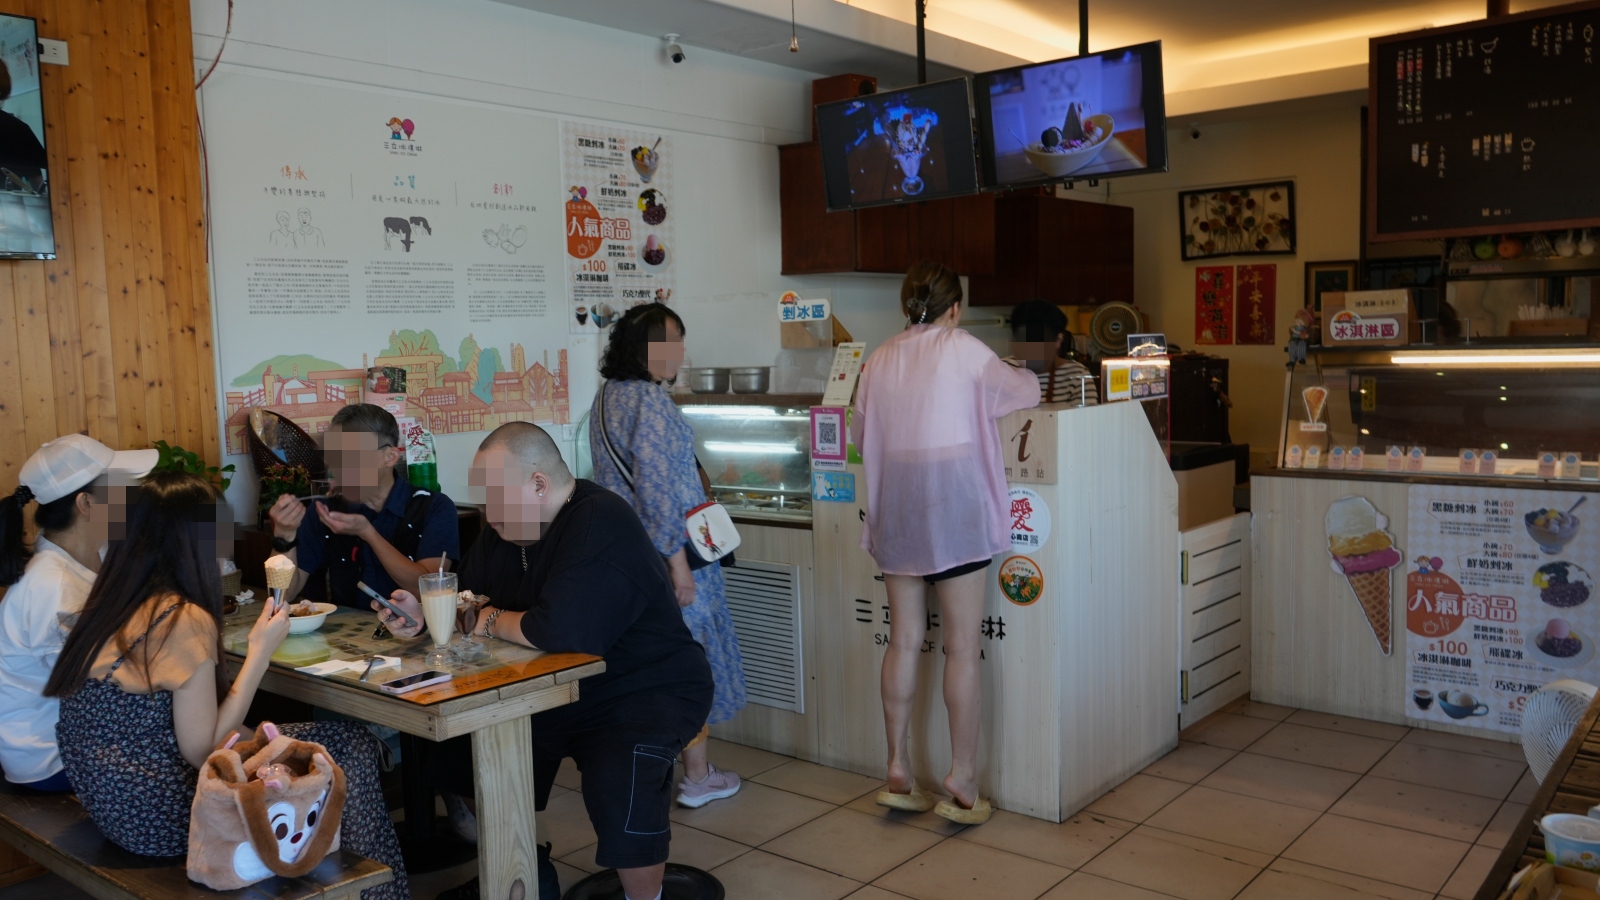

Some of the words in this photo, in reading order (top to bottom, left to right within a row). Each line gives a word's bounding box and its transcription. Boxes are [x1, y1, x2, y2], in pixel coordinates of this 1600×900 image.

[279, 165, 308, 181] 傳承
[393, 175, 416, 190] 品質
[492, 183, 513, 197] 創新
[567, 216, 632, 240] 人氣商品
[582, 260, 606, 272] $100
[576, 273, 609, 283] 冰淇淋咖啡
[782, 304, 825, 320] 剉冰區
[1334, 323, 1395, 338] 冰淇淋區
[1432, 502, 1477, 515] 黑糖剉冰
[1484, 499, 1499, 507] 小碗
[1484, 508, 1499, 516] 大碗
[1483, 542, 1498, 551] 小碗
[1499, 543, 1513, 551] $70
[1482, 550, 1498, 558] 大碗
[1499, 551, 1513, 559] $80
[1466, 557, 1513, 571] 鮮奶剉冰
[1408, 589, 1518, 623] 人氣商品
[1473, 624, 1504, 634] 黑糖剉冰
[1504, 628, 1519, 636] $90
[1473, 633, 1504, 642] 鮮奶剉冰
[1504, 637, 1524, 645] $100
[920, 640, 936, 653] CE
[1429, 639, 1468, 656] $100
[1489, 646, 1523, 660] 飛碟冰
[1417, 652, 1472, 669] 冰淇淋咖啡
[1494, 679, 1541, 695] 巧克力聖
